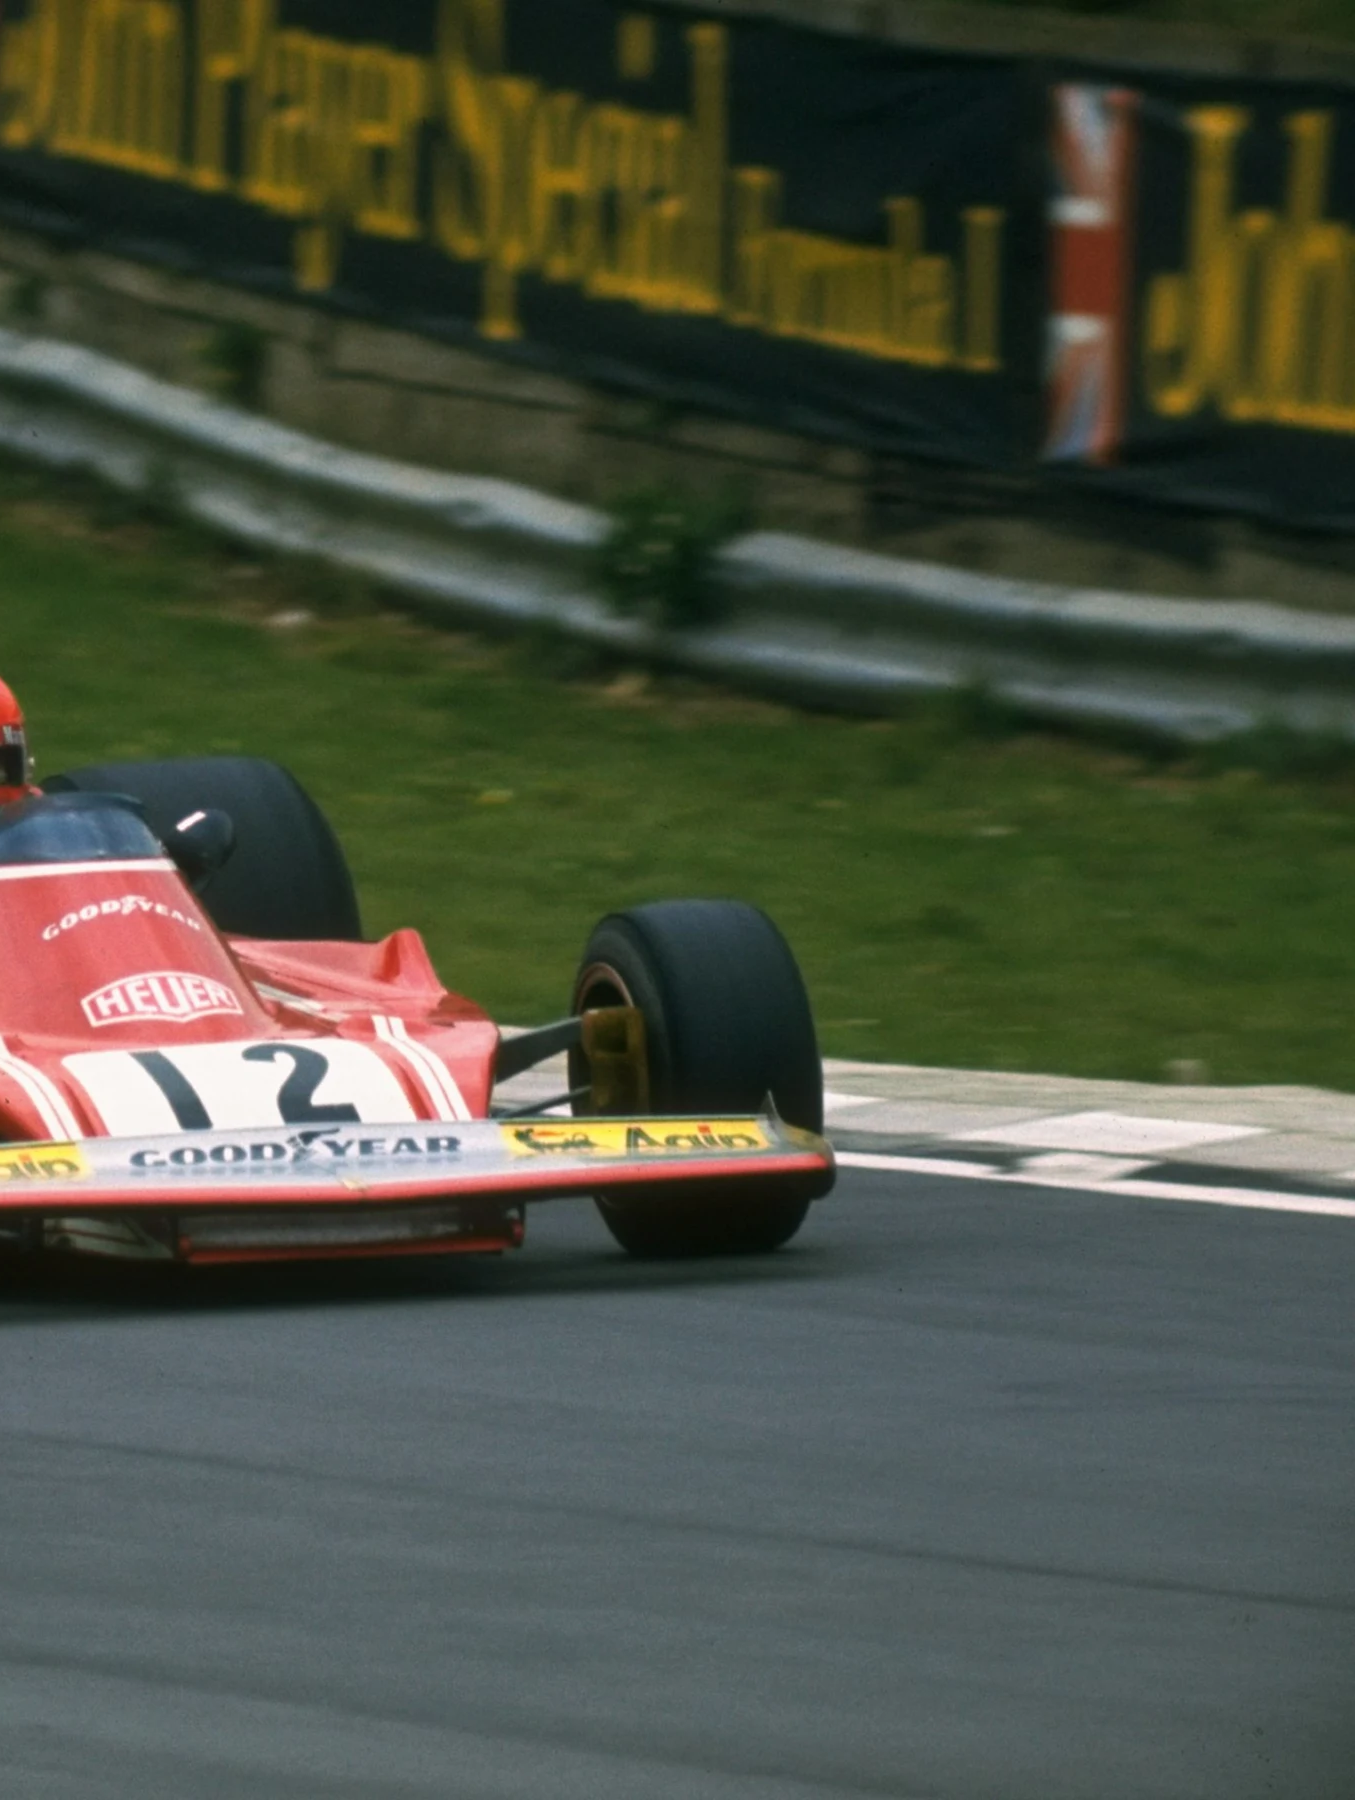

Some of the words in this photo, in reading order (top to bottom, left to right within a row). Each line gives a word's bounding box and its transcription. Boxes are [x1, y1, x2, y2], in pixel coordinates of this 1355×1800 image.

[42, 895, 200, 941] GOODYEAR
[94, 975, 230, 1018] HEUER
[130, 1042, 362, 1130] 12
[130, 1127, 463, 1168] GOODYEAR
